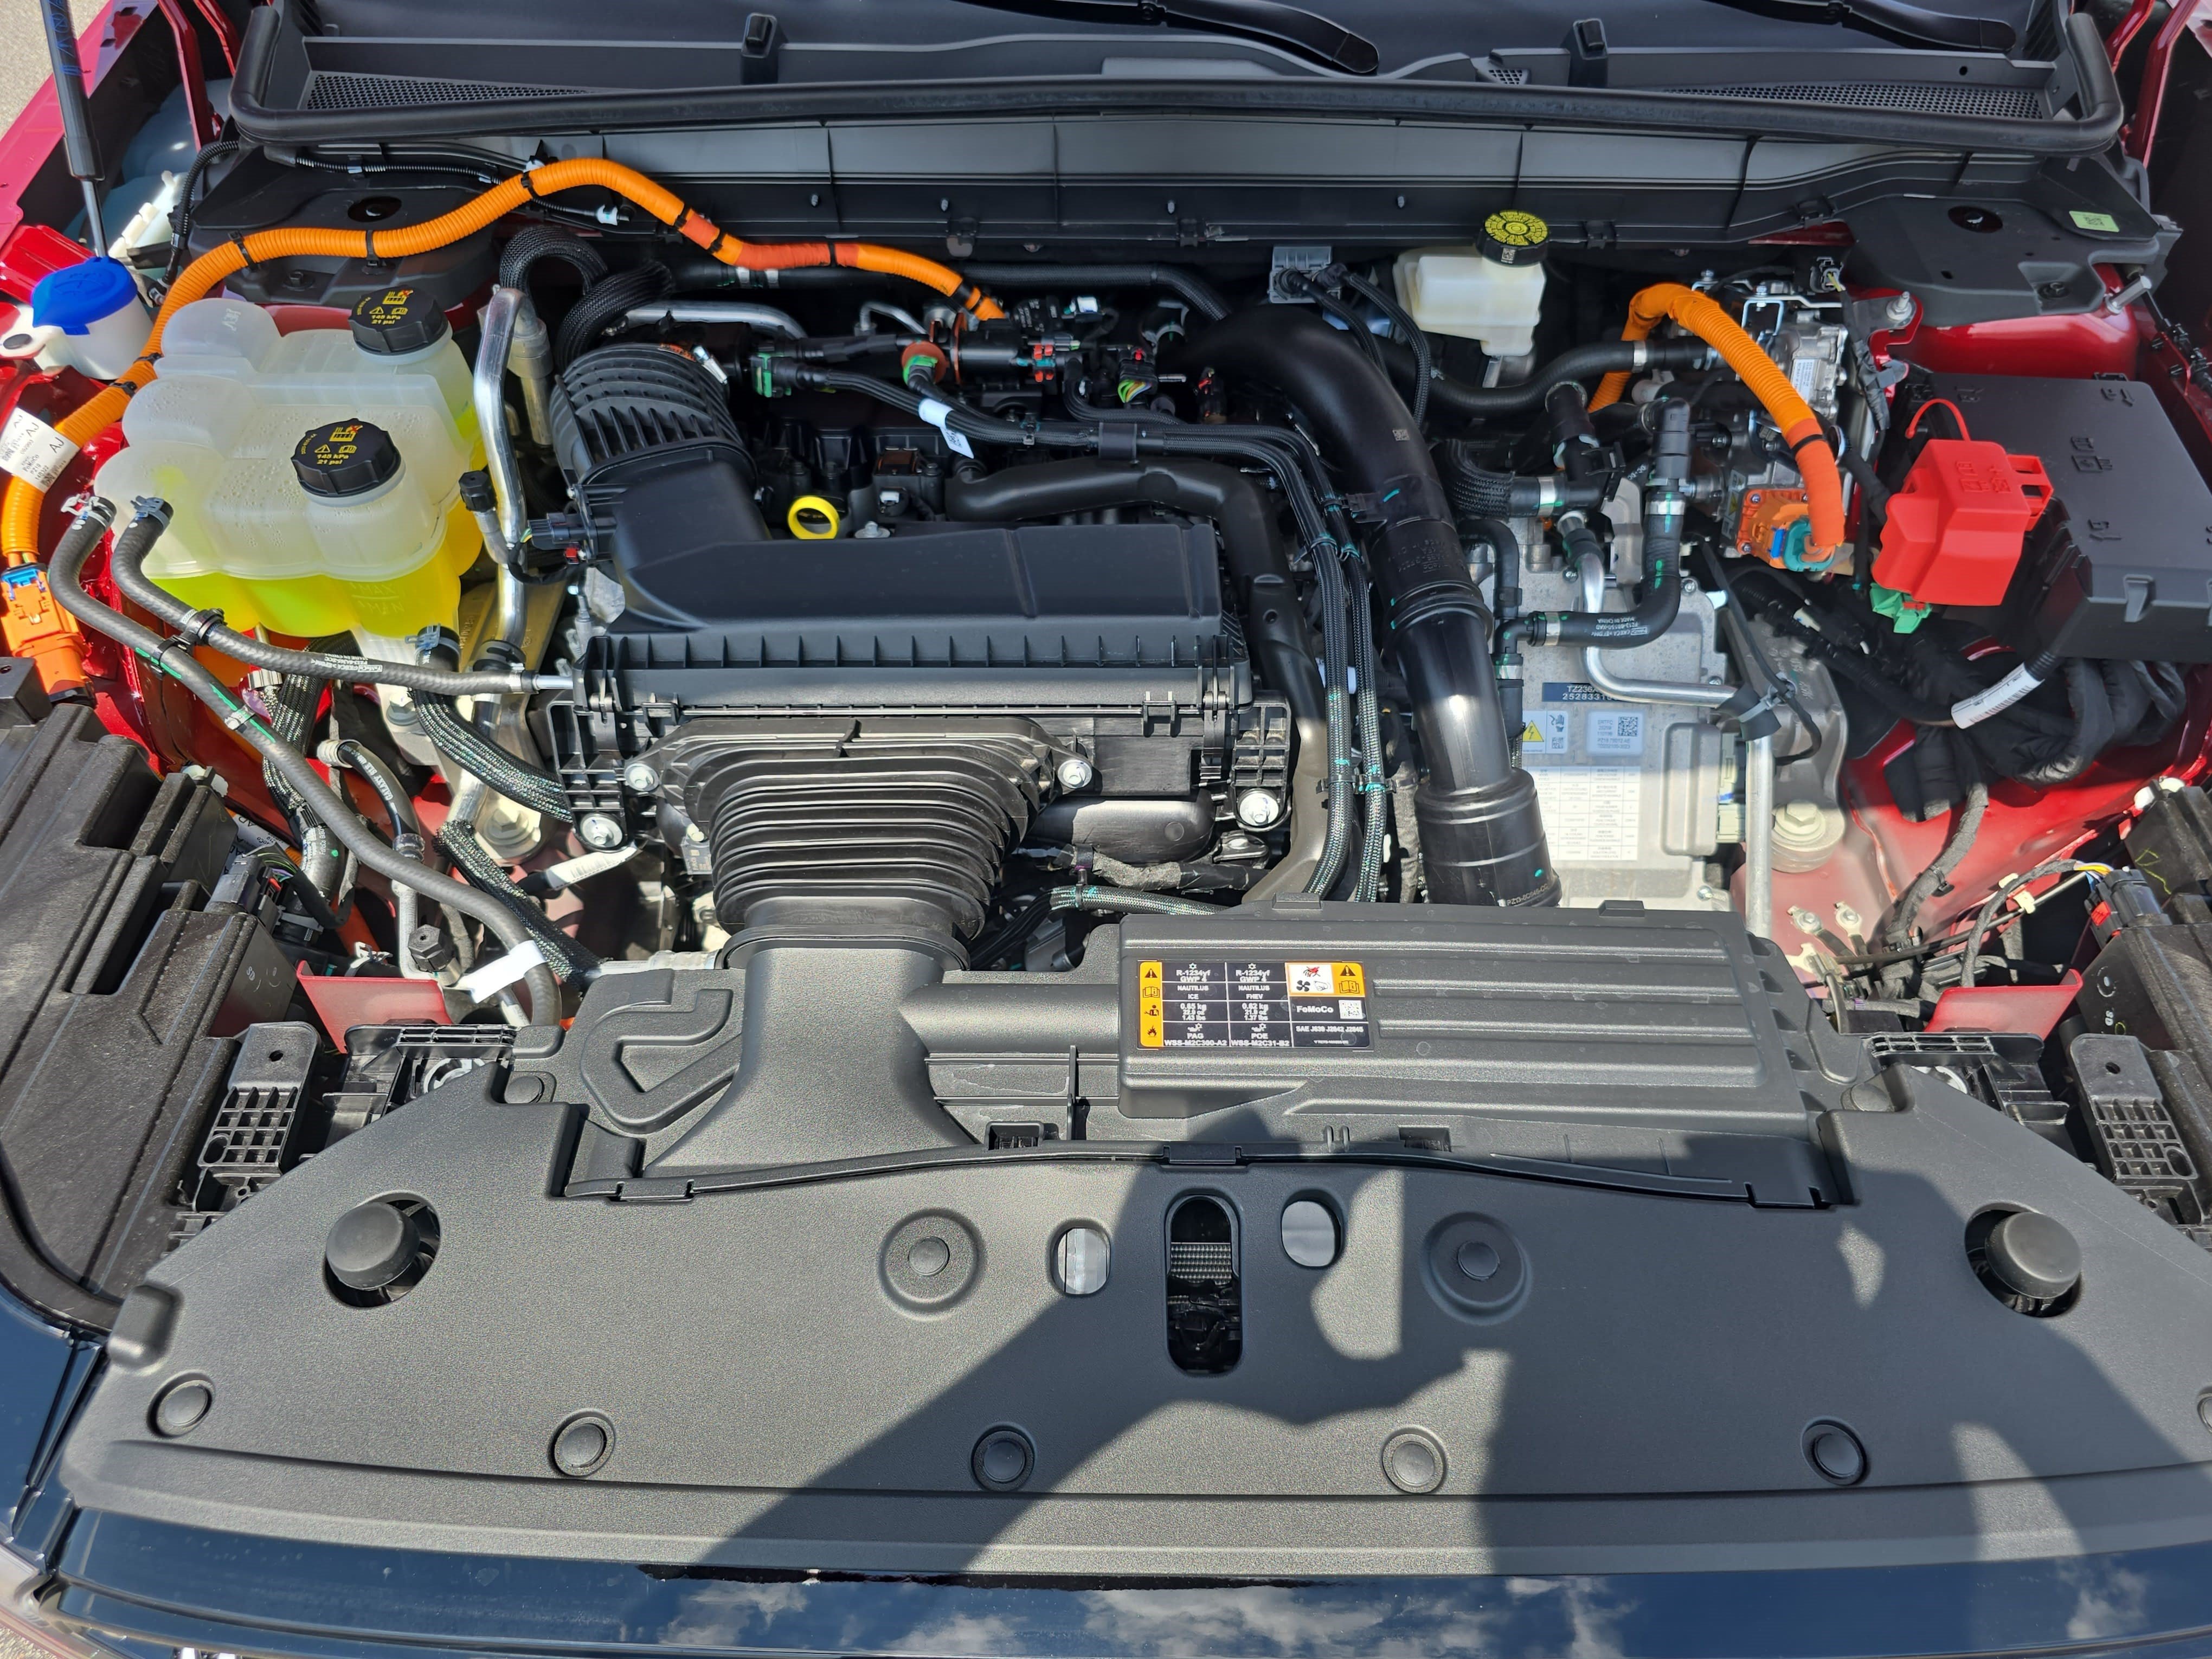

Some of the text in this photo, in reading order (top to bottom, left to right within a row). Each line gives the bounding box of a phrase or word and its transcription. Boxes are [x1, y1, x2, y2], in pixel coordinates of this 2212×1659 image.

[26, 422, 40, 437] AJ
[49, 437, 65, 453] AJ
[373, 775, 393, 801] GALAXY
[1197, 1003, 1207, 1011] kg
[1259, 1003, 1268, 1011] kg
